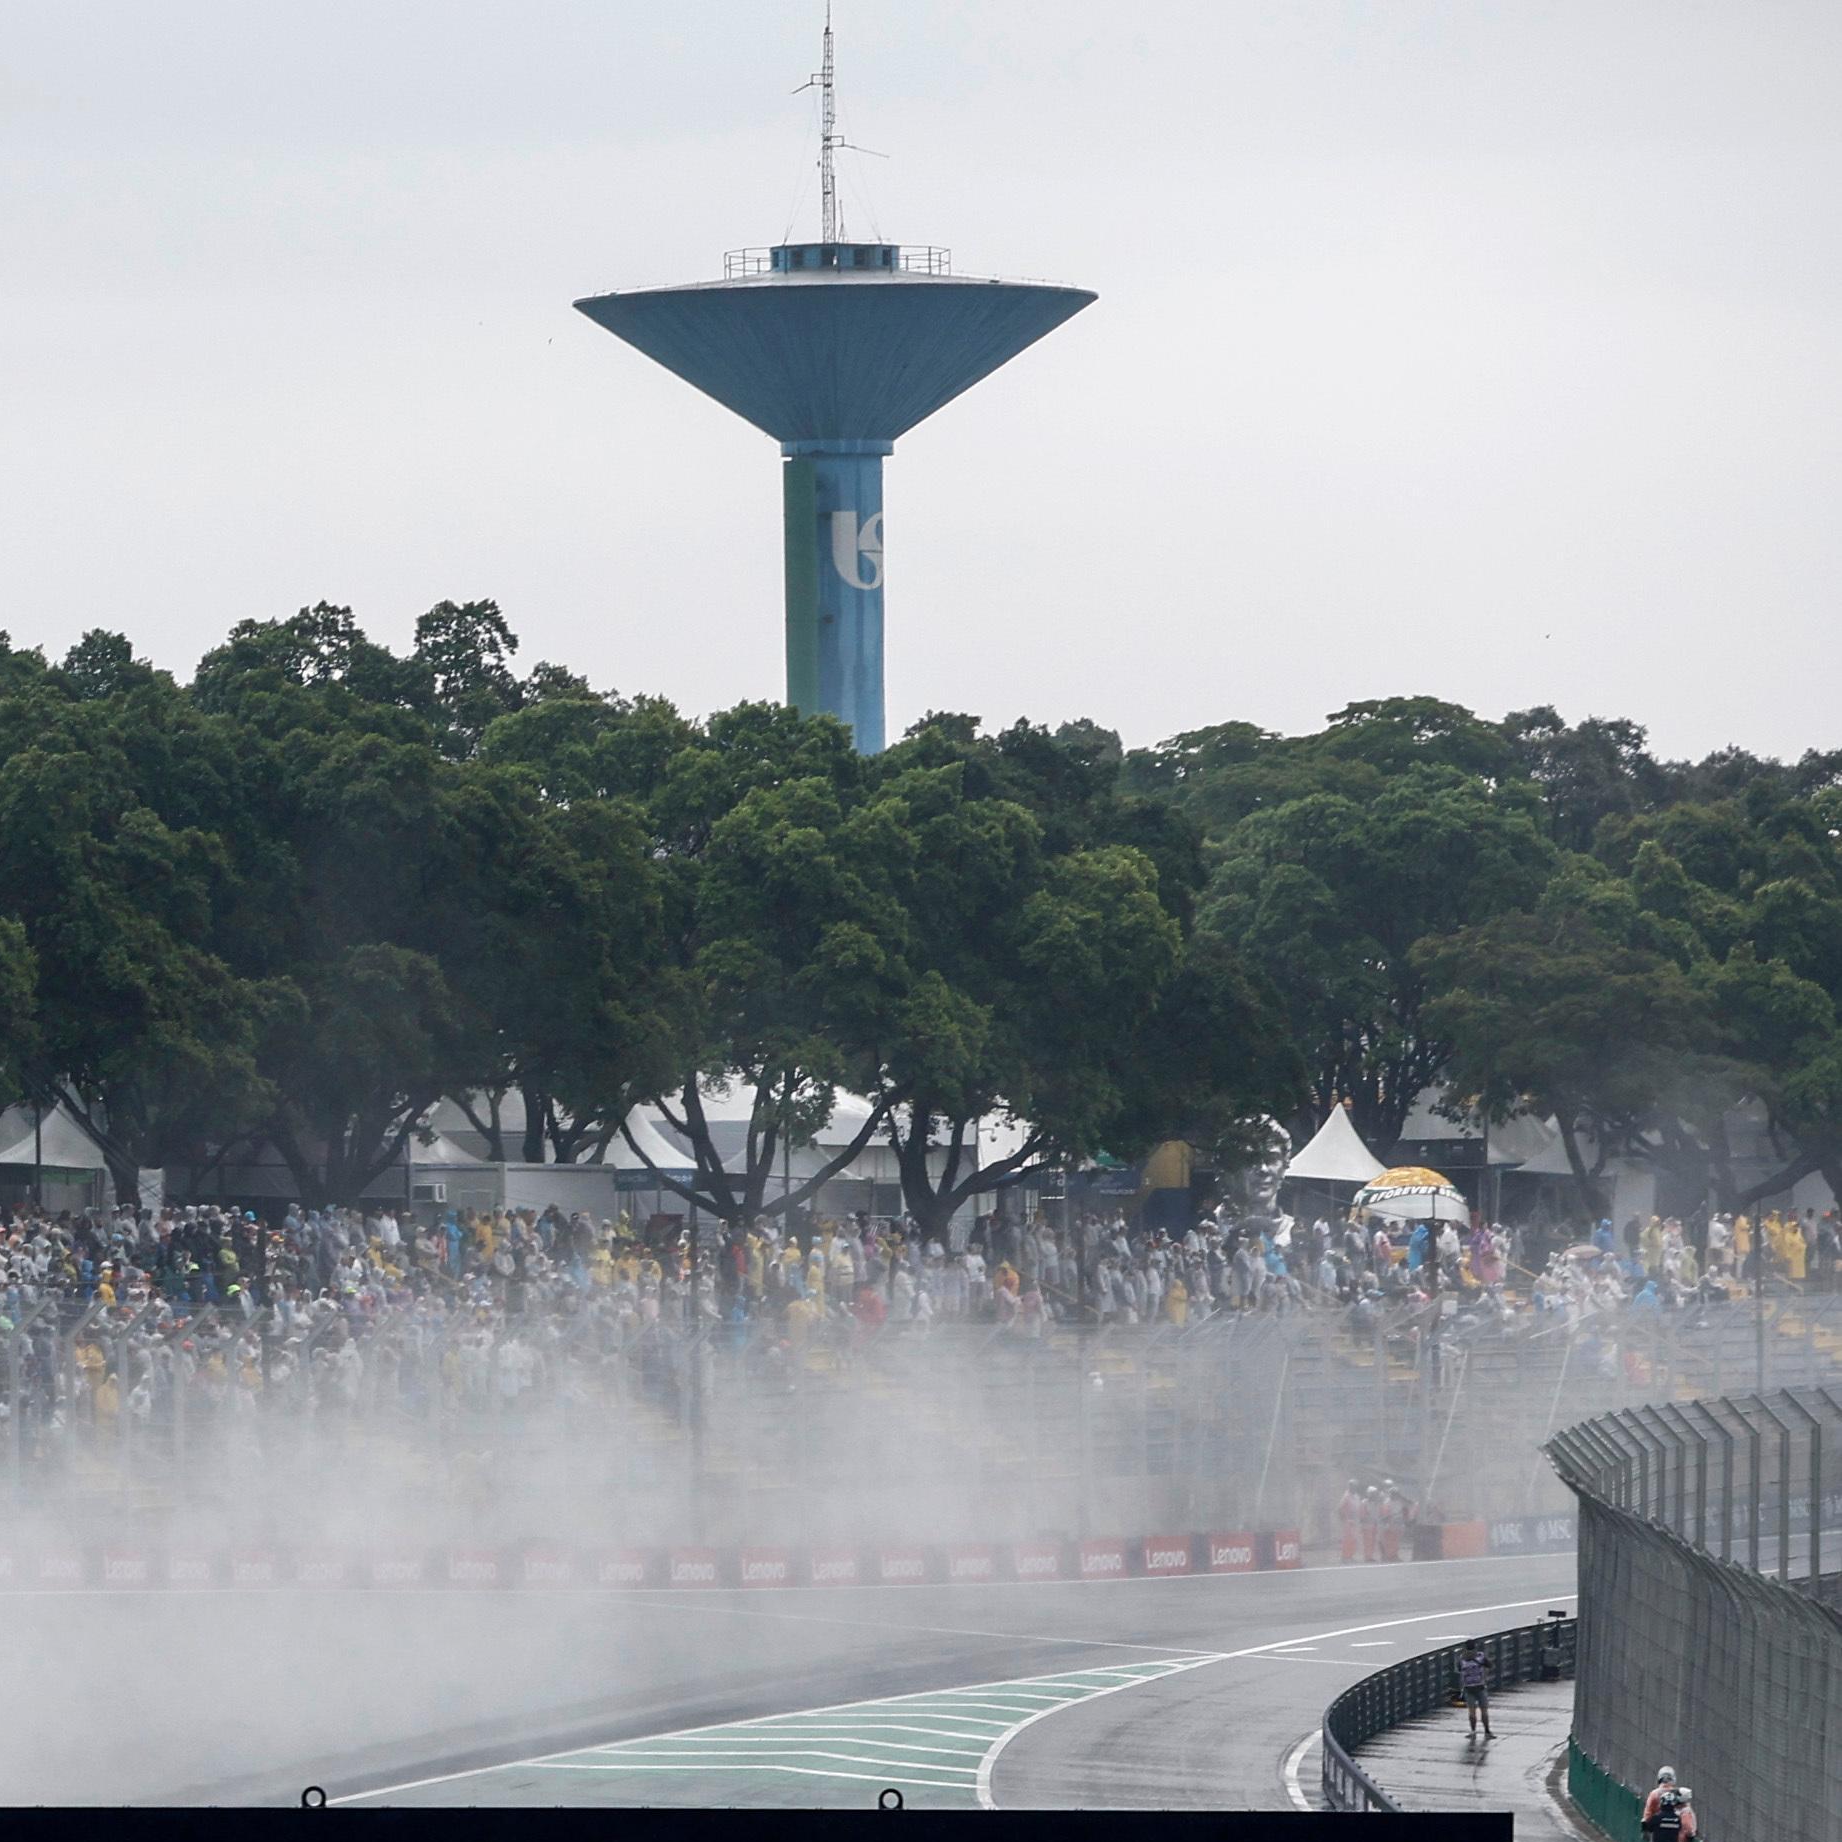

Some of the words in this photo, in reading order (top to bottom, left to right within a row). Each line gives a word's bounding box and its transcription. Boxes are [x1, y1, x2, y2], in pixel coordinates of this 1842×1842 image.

[1546, 1519, 1572, 1539] MSC
[1081, 1551, 1121, 1573] Lenovo
[1146, 1547, 1187, 1570] Lenovo
[1212, 1543, 1252, 1567] Lenovo
[670, 1558, 712, 1581] Lenovo
[742, 1557, 785, 1581] Lenovo
